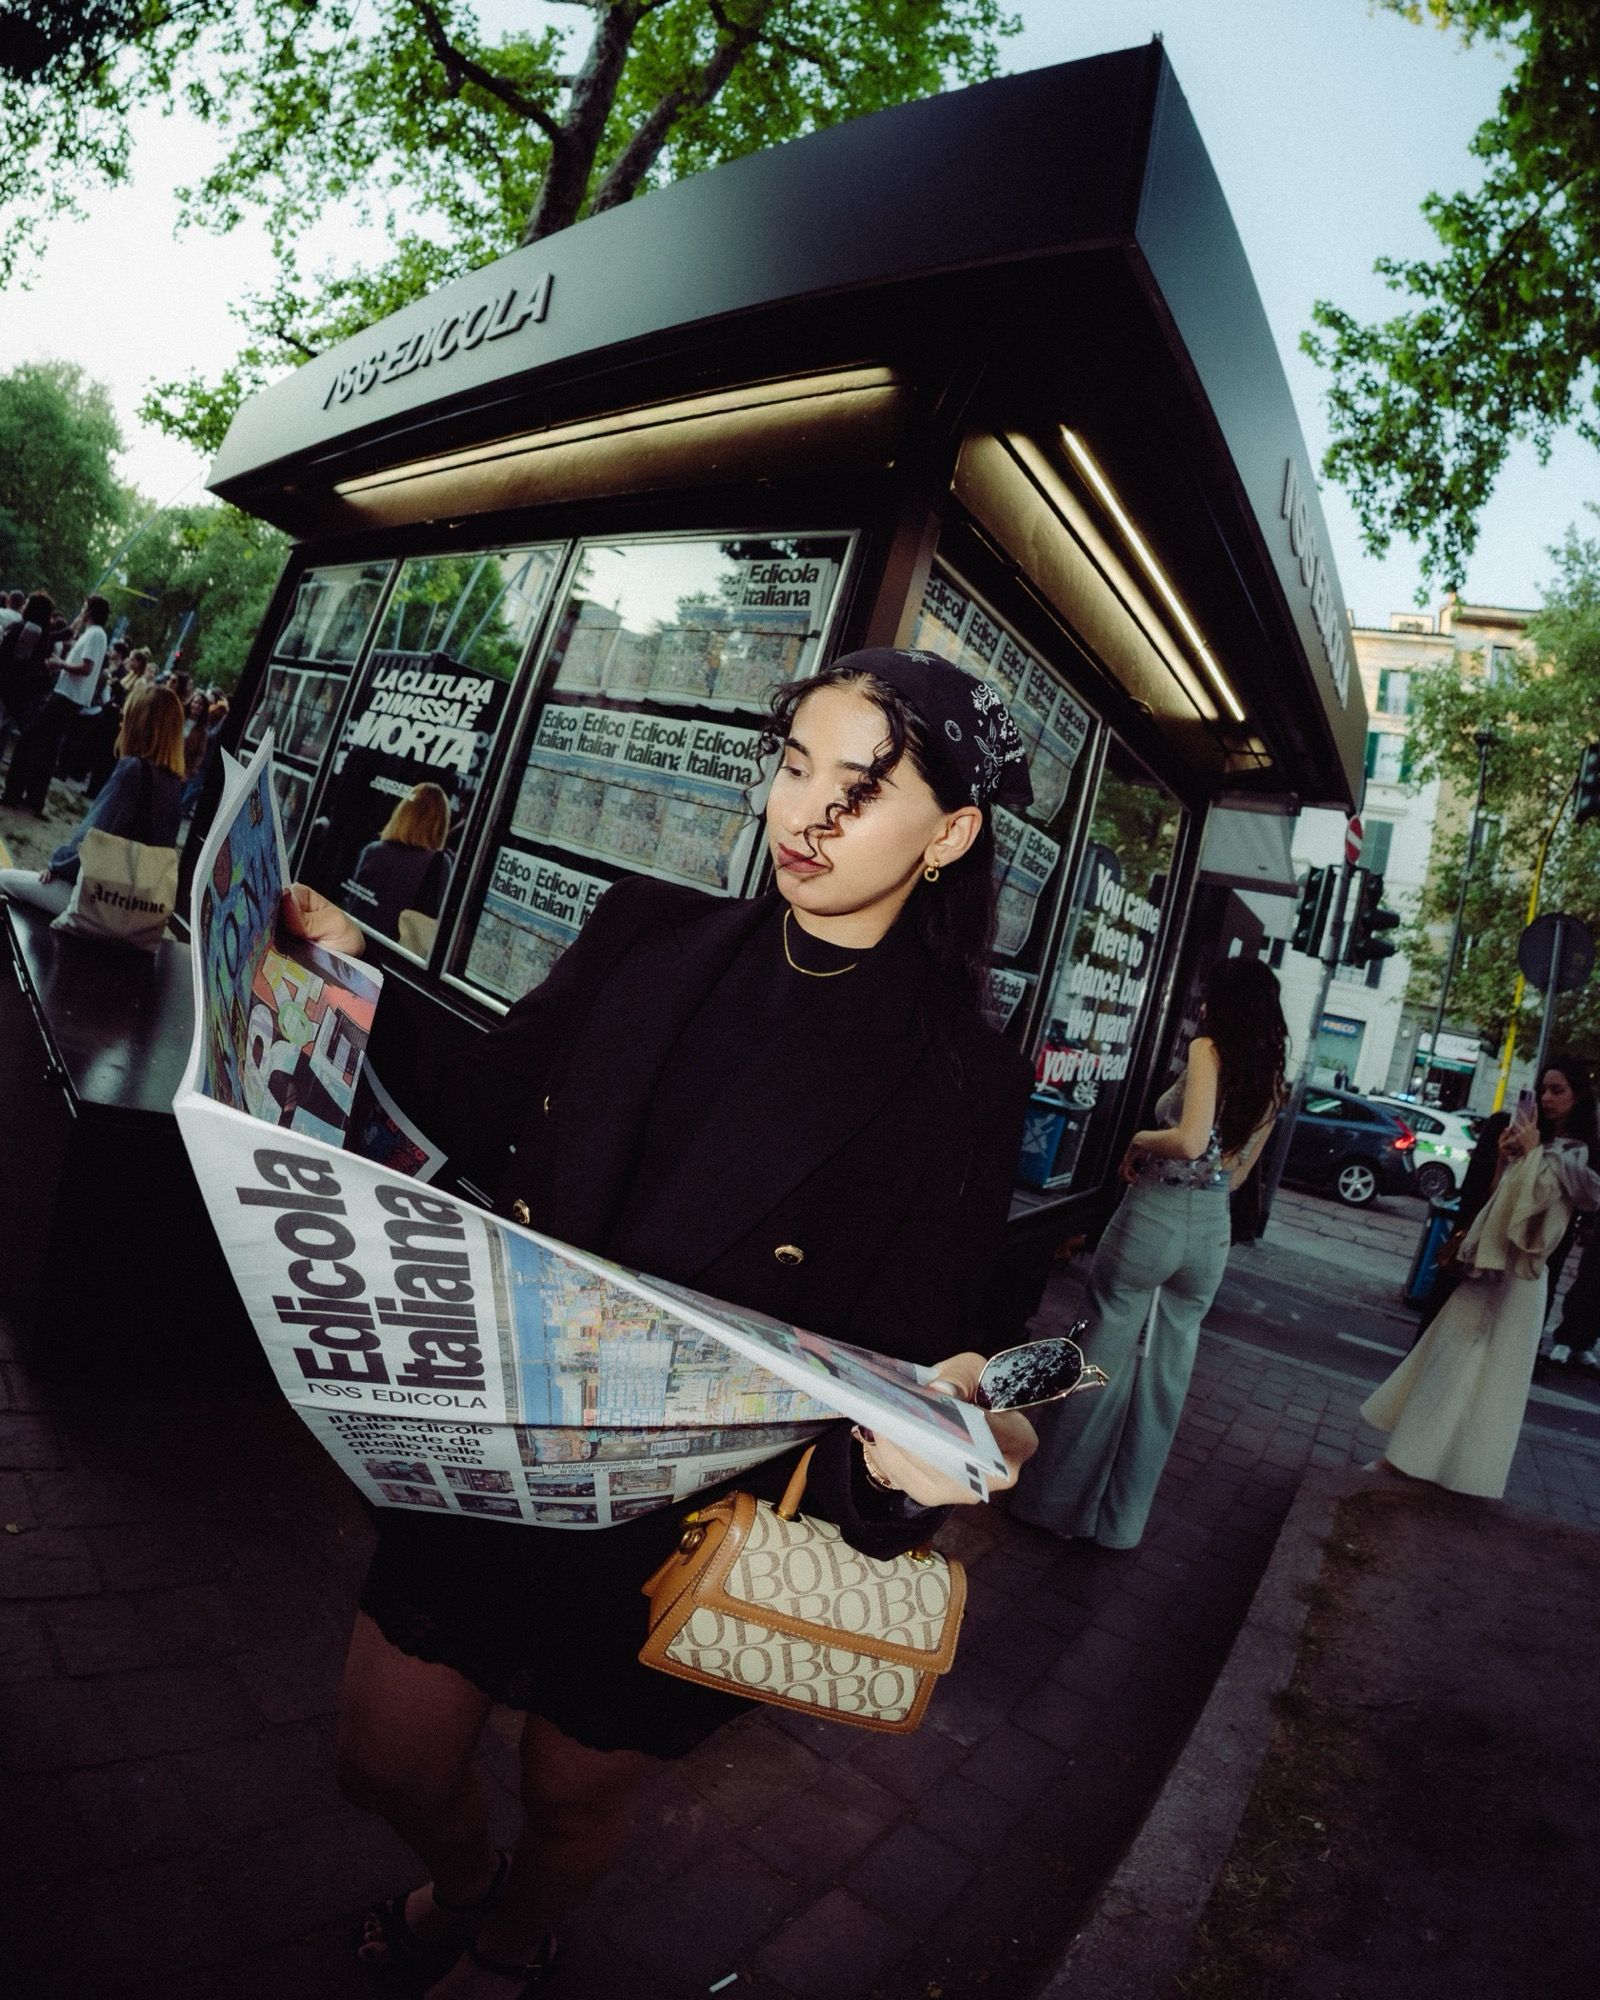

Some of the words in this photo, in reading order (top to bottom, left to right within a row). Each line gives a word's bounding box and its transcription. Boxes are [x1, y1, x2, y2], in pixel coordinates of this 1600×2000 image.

[382, 271, 554, 385] EDICOLA
[749, 563, 820, 584] Edicola
[742, 585, 811, 606] Italiana
[371, 668, 400, 690] LA
[397, 670, 495, 705] CULTURA
[370, 690, 395, 713] DI
[387, 693, 462, 728] MASSA
[543, 710, 577, 731] Edico
[349, 710, 478, 775] MORTA
[536, 729, 573, 752] Italian
[692, 728, 760, 761] Edicola
[686, 751, 752, 785] Italiana
[491, 871, 527, 903] Italian
[1095, 863, 1126, 918] You
[1124, 892, 1160, 934] came
[530, 887, 575, 922] Italian
[1091, 912, 1129, 962] here
[1128, 933, 1144, 969] to
[1070, 953, 1120, 1003] dance
[1094, 1012, 1132, 1044] want
[1042, 1050, 1075, 1092] you
[1076, 1049, 1095, 1082] to
[1094, 1046, 1132, 1082] read
[235, 1148, 392, 1385] Edicola
[374, 1184, 487, 1392] Italiana
[372, 1389, 487, 1409] EDICOLA
[336, 1422, 395, 1433] delle
[402, 1424, 494, 1435] edicole
[348, 1414, 425, 1423] futuro
[342, 1431, 444, 1444] dipende
[449, 1436, 481, 1447] da
[348, 1440, 421, 1451] quello
[428, 1445, 485, 1456] delle
[353, 1449, 428, 1459] nostre
[433, 1454, 483, 1465] città
